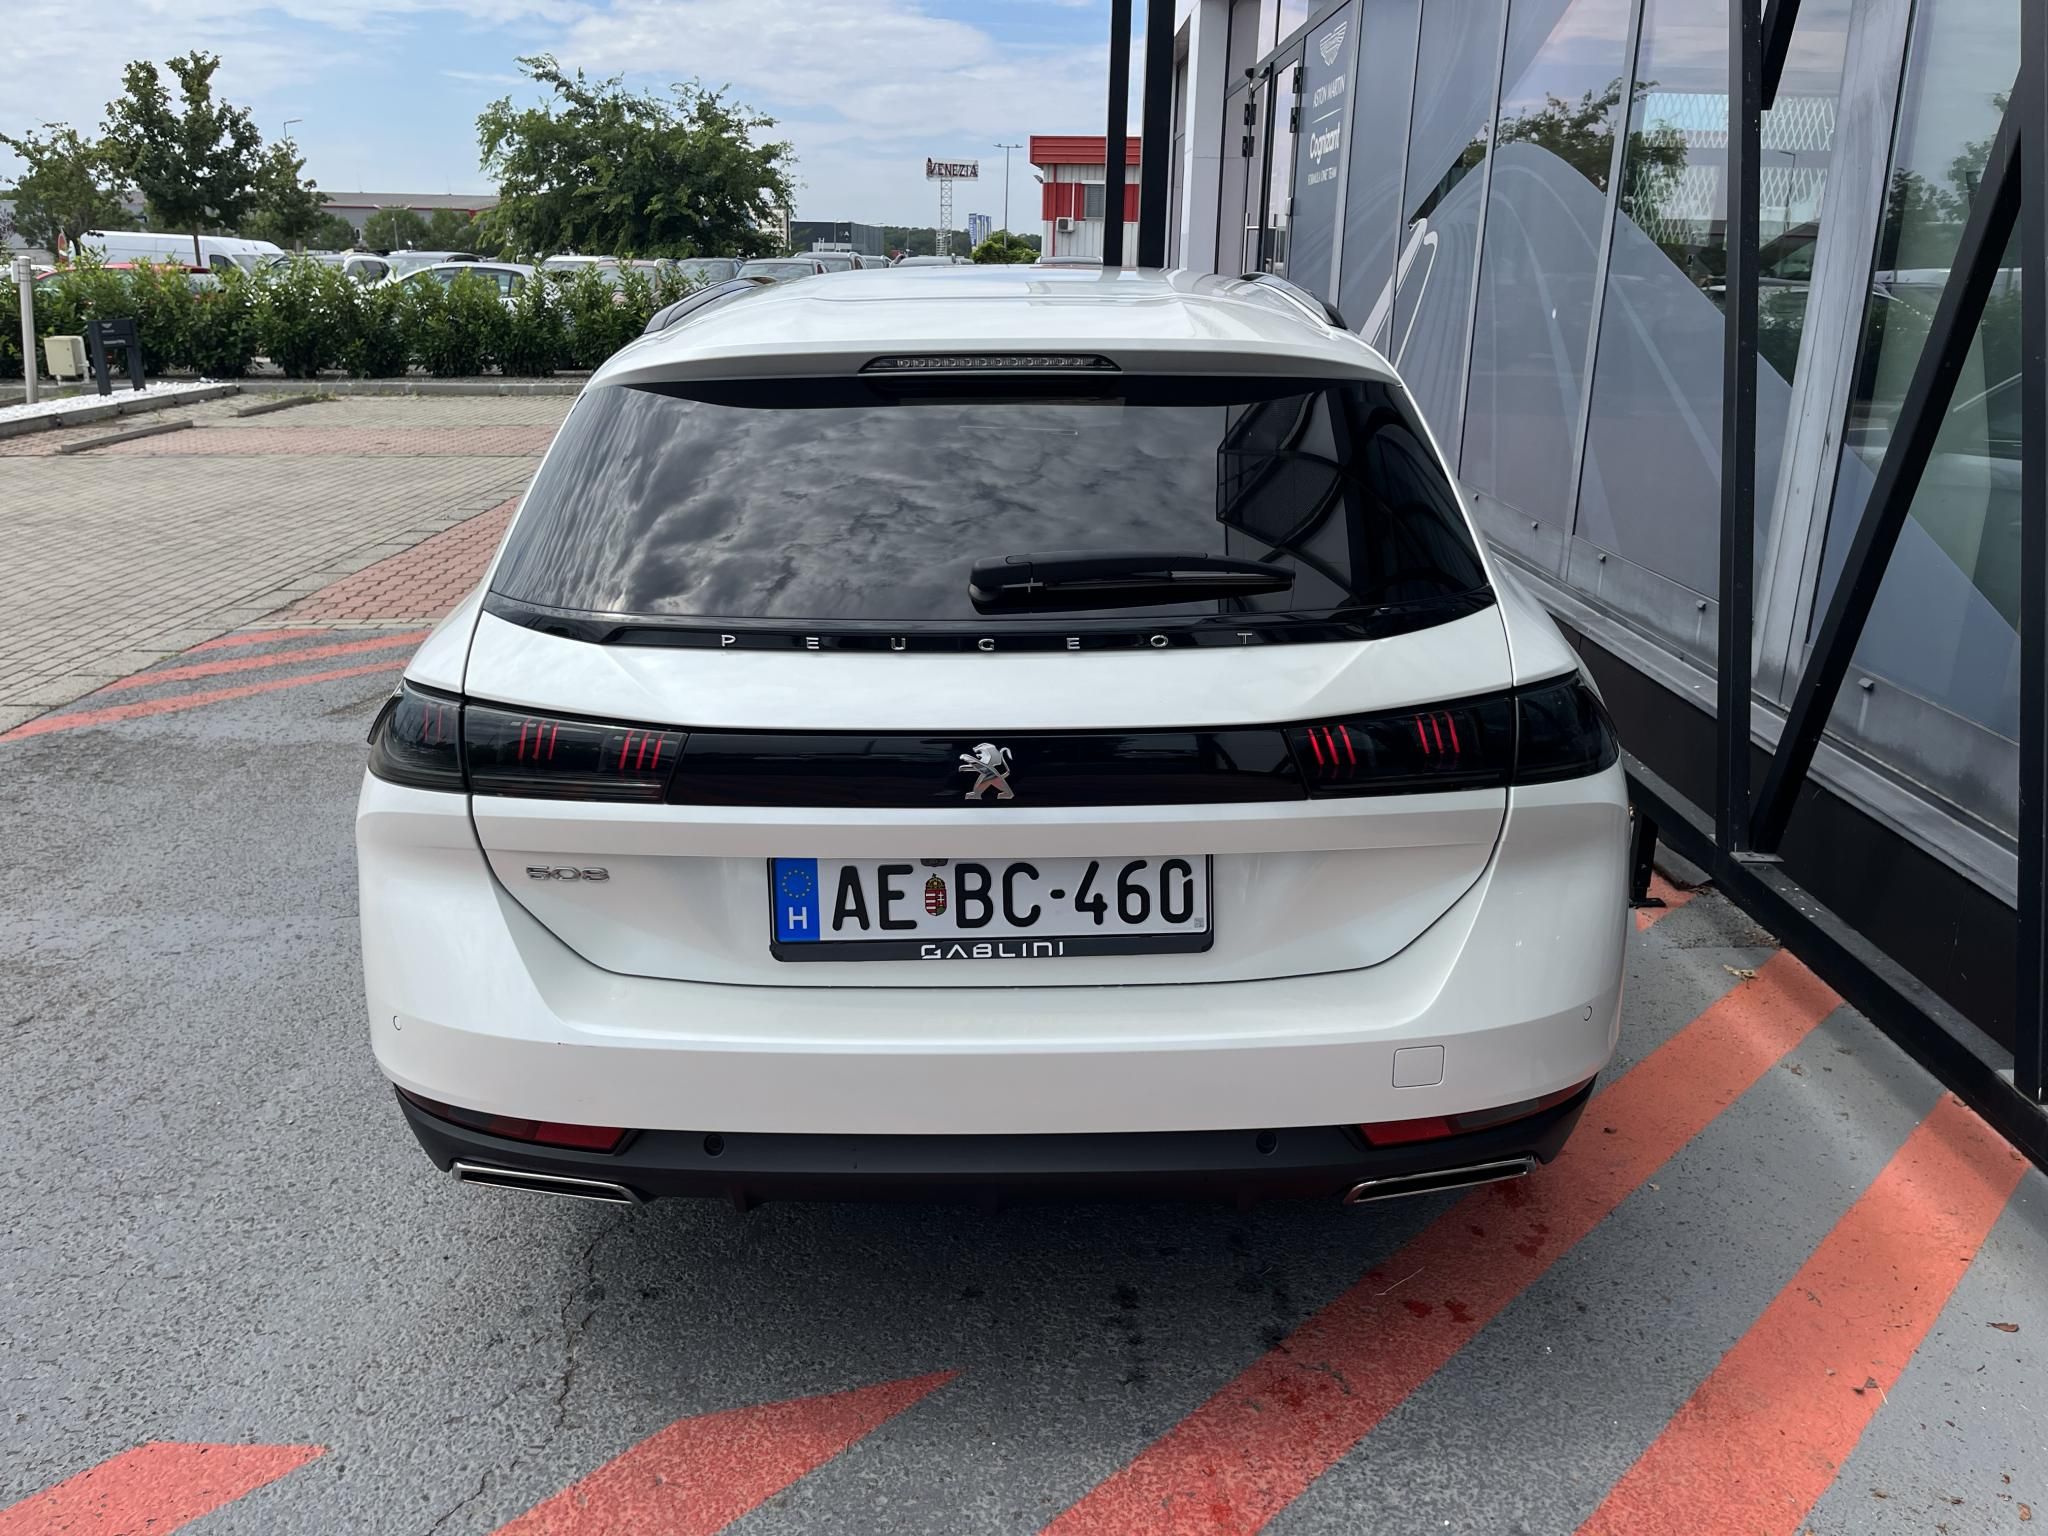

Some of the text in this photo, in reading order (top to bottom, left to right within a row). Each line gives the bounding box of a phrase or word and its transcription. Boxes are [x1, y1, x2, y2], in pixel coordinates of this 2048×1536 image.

[1309, 121, 1341, 164] Cognizant
[929, 162, 978, 178] VENEZIA
[720, 632, 1253, 651] PEUGEOT
[526, 865, 610, 883] 508
[831, 864, 918, 931] AE
[788, 906, 808, 930] H
[920, 940, 1064, 960] GABLINI
